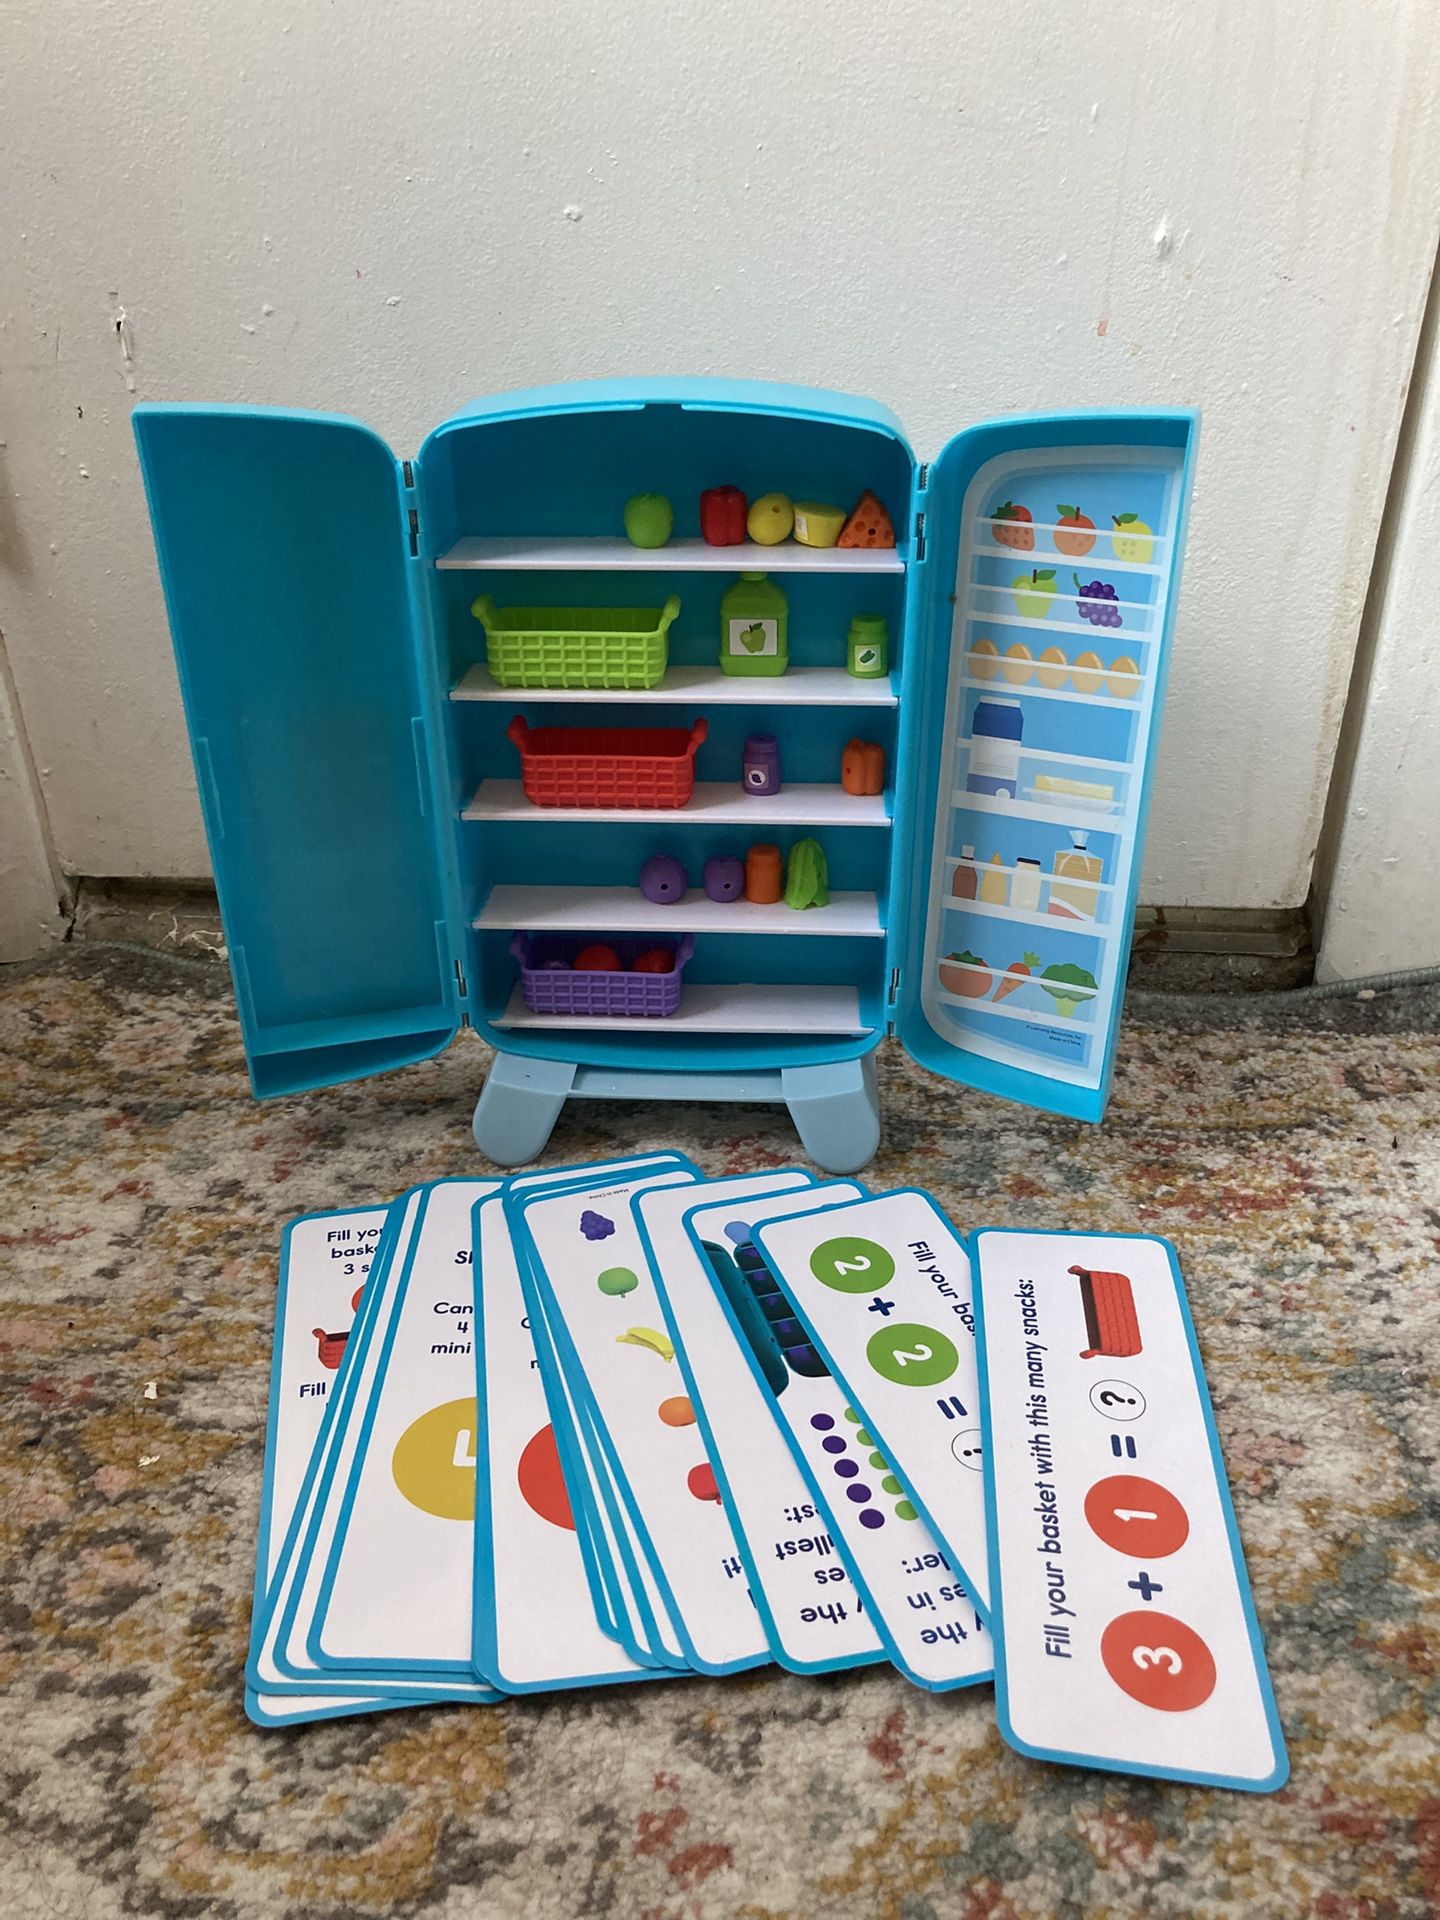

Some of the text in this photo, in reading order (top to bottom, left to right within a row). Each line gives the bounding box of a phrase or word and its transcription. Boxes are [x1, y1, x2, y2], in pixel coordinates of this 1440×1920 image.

[327, 1228, 382, 1242] Fill yo
[331, 1243, 377, 1259] bask
[343, 1263, 355, 1275] 3
[907, 1240, 976, 1337] Fill your bas
[433, 1301, 474, 1314] Can
[833, 1255, 872, 1276] 2
[892, 1343, 933, 1367] 2
[457, 1321, 469, 1334] 4
[431, 1341, 472, 1354] mini
[299, 1381, 326, 1398] Fill
[1014, 1278, 1077, 1659] Fill your basket with this many snacks:
[1113, 1507, 1159, 1522] 1
[906, 1592, 937, 1611] in
[800, 1602, 848, 1624] the
[920, 1621, 968, 1645] the
[1132, 1645, 1183, 1676] 3
